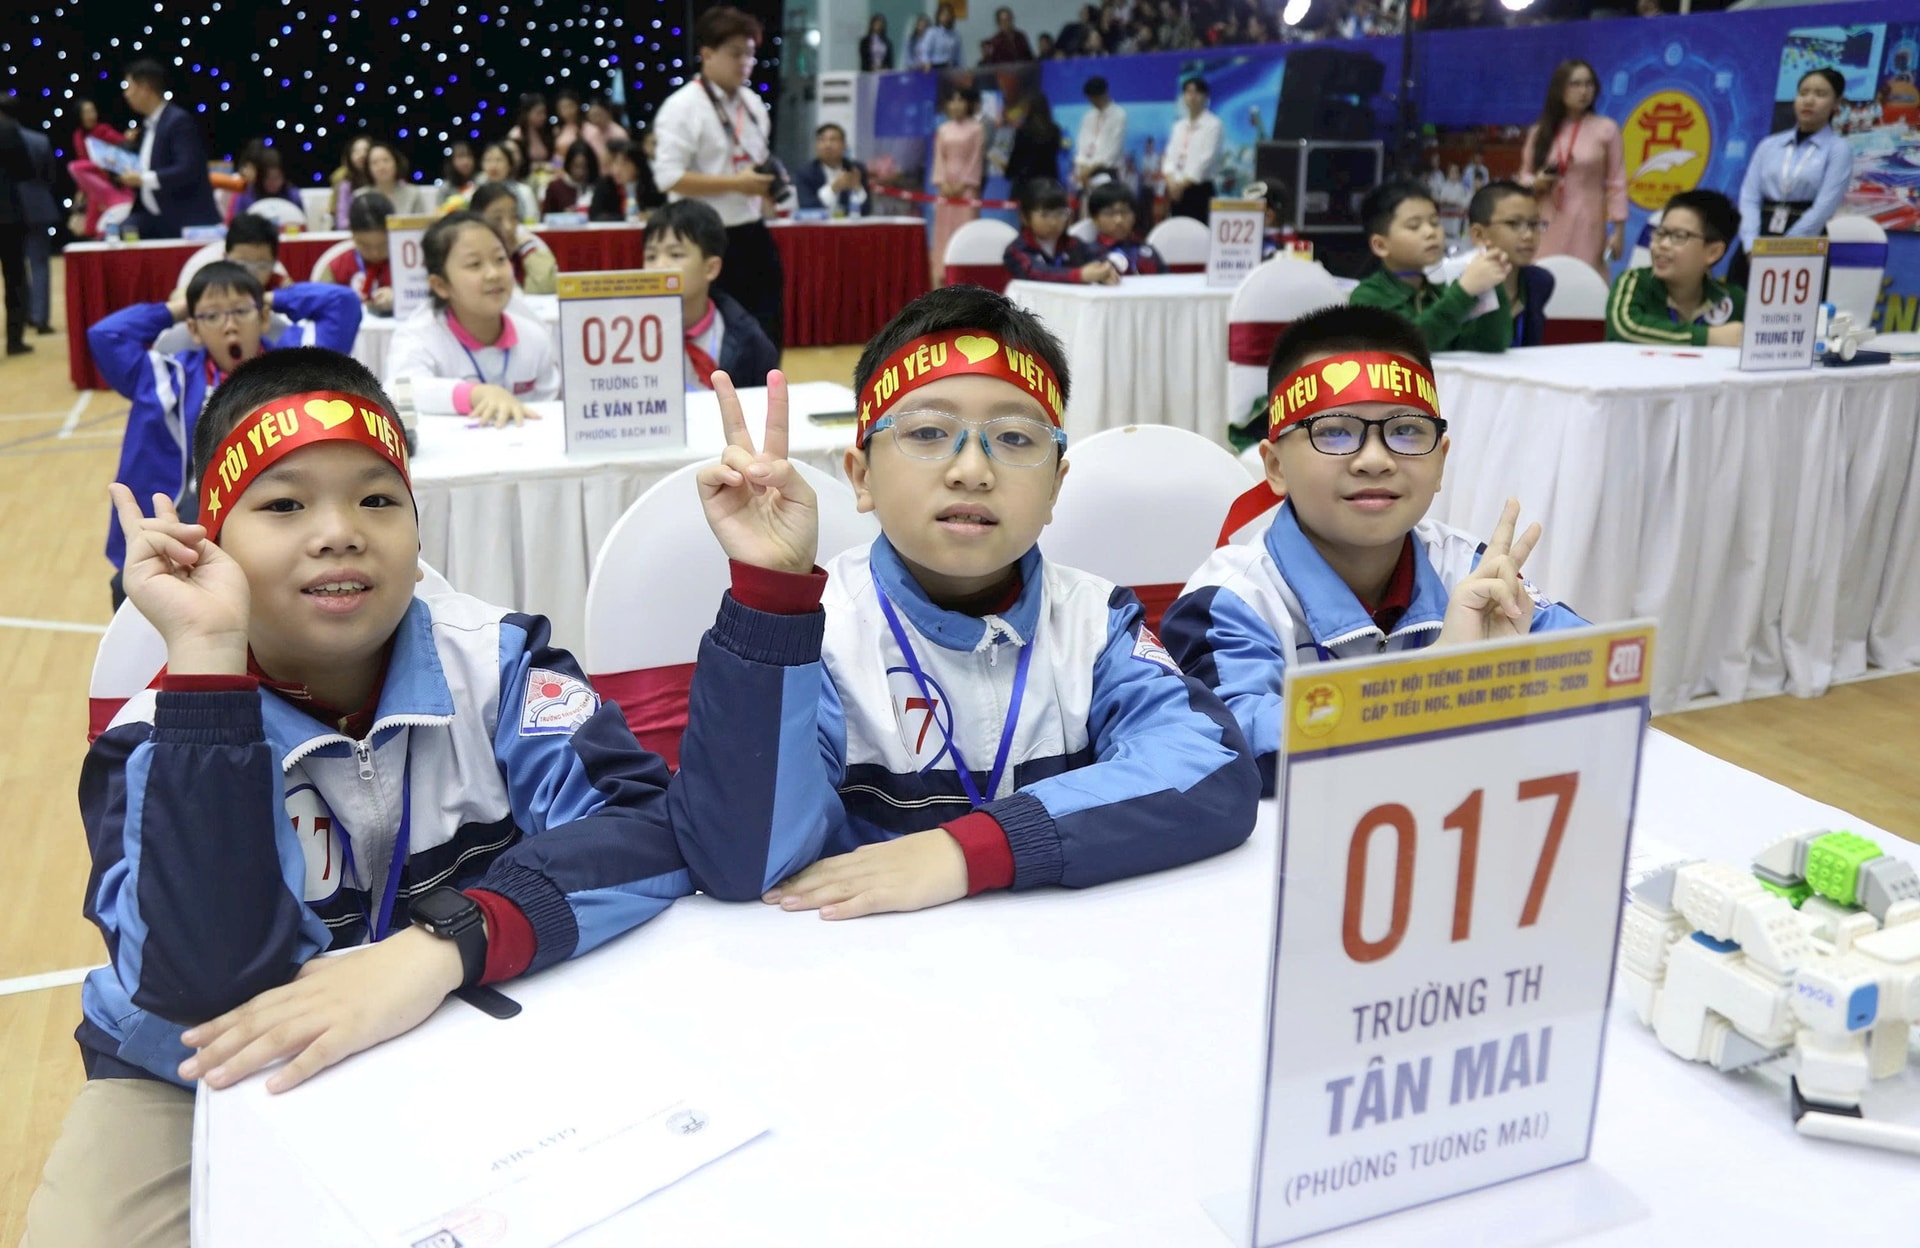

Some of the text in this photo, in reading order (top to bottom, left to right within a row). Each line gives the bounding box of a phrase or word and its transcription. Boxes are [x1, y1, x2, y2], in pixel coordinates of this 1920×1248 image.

[1219, 219, 1255, 244] 022
[1760, 267, 1811, 306] 019
[582, 314, 664, 366] 020
[1755, 331, 1789, 346] TRUNG
[644, 375, 658, 388] TH
[874, 365, 900, 409] TÔI
[903, 341, 948, 381] YÊU
[1005, 345, 1044, 393] VIỆT
[1286, 373, 1318, 413] YÊU
[1366, 360, 1412, 397] VIỆT
[583, 400, 600, 419] LÊ
[218, 407, 401, 493] TÔI YÊU VIỆT
[1362, 649, 1593, 699] NGÀY HỘI TIẾNG ANH STEM ROBOTICS
[1362, 702, 1389, 723] CẤP
[1394, 695, 1420, 718] TIỂU
[1457, 689, 1487, 708] NĂM
[1490, 684, 1515, 704] HỌC
[1519, 679, 1549, 699] 2025
[291, 815, 332, 881] 7
[1342, 771, 1581, 964] 017
[1352, 964, 1544, 1044] TRƯỜNG TH
[1325, 1026, 1553, 1138] TÂN MAI
[1284, 1151, 1398, 1208] (PHƯỜNG
[1497, 1110, 1550, 1149] MAI)
